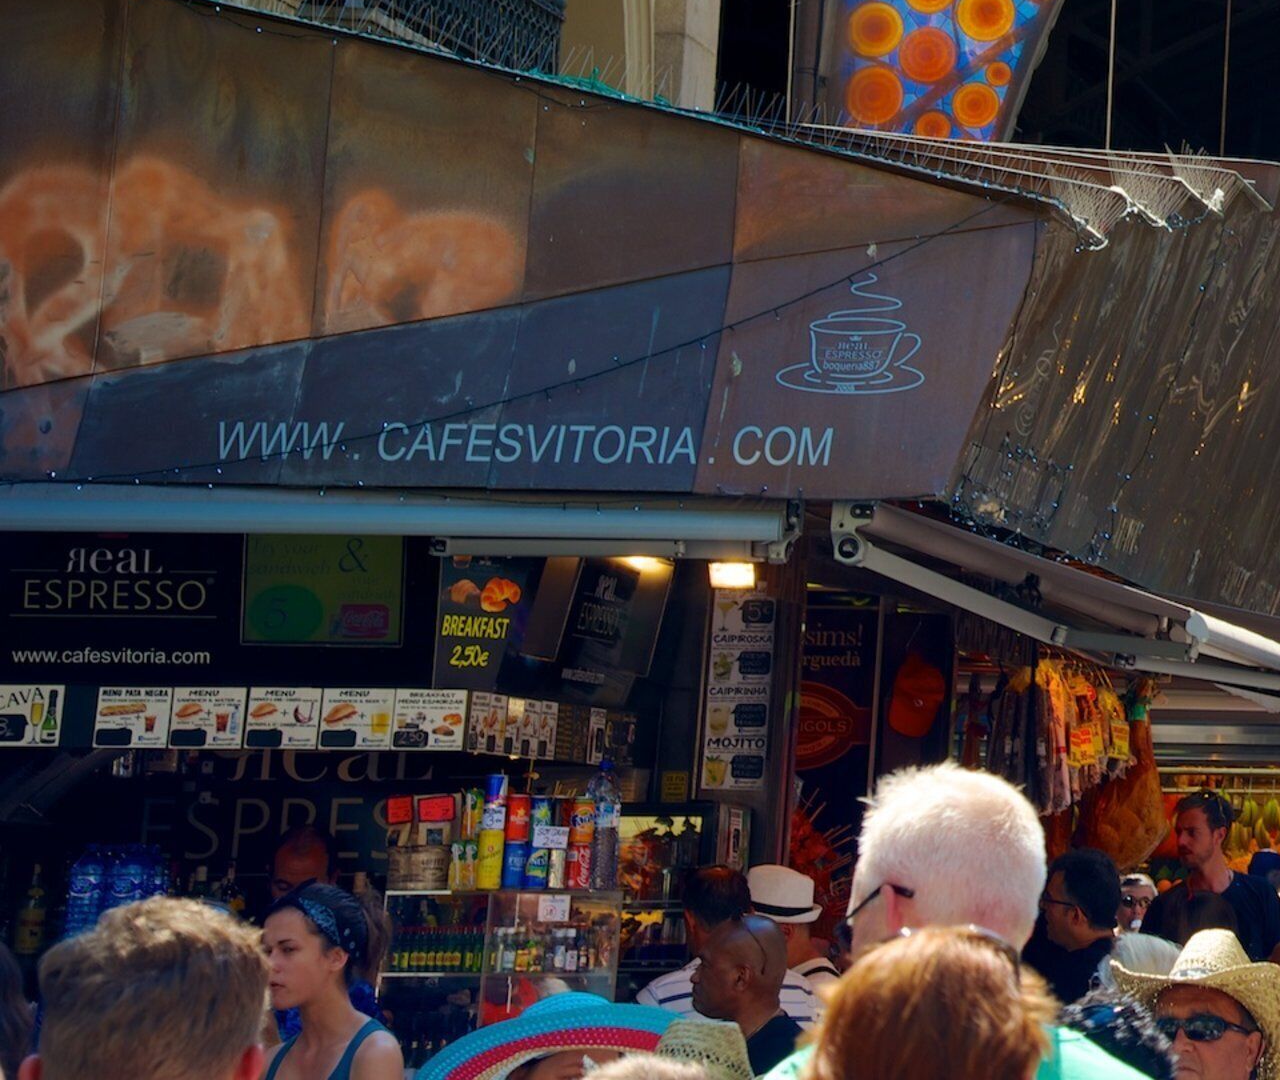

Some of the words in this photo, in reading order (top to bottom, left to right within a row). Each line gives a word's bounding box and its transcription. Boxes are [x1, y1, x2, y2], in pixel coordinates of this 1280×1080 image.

[23, 578, 207, 611] ESPRESSO
[441, 612, 511, 639] BREAKFAST
[713, 634, 773, 644] CAIPIROSKA
[11, 646, 211, 665] www.cafesvitoria.com
[102, 689, 122, 697] MENU
[709, 686, 768, 697] CAIPIRINHA
[707, 737, 766, 749] MOJITO
